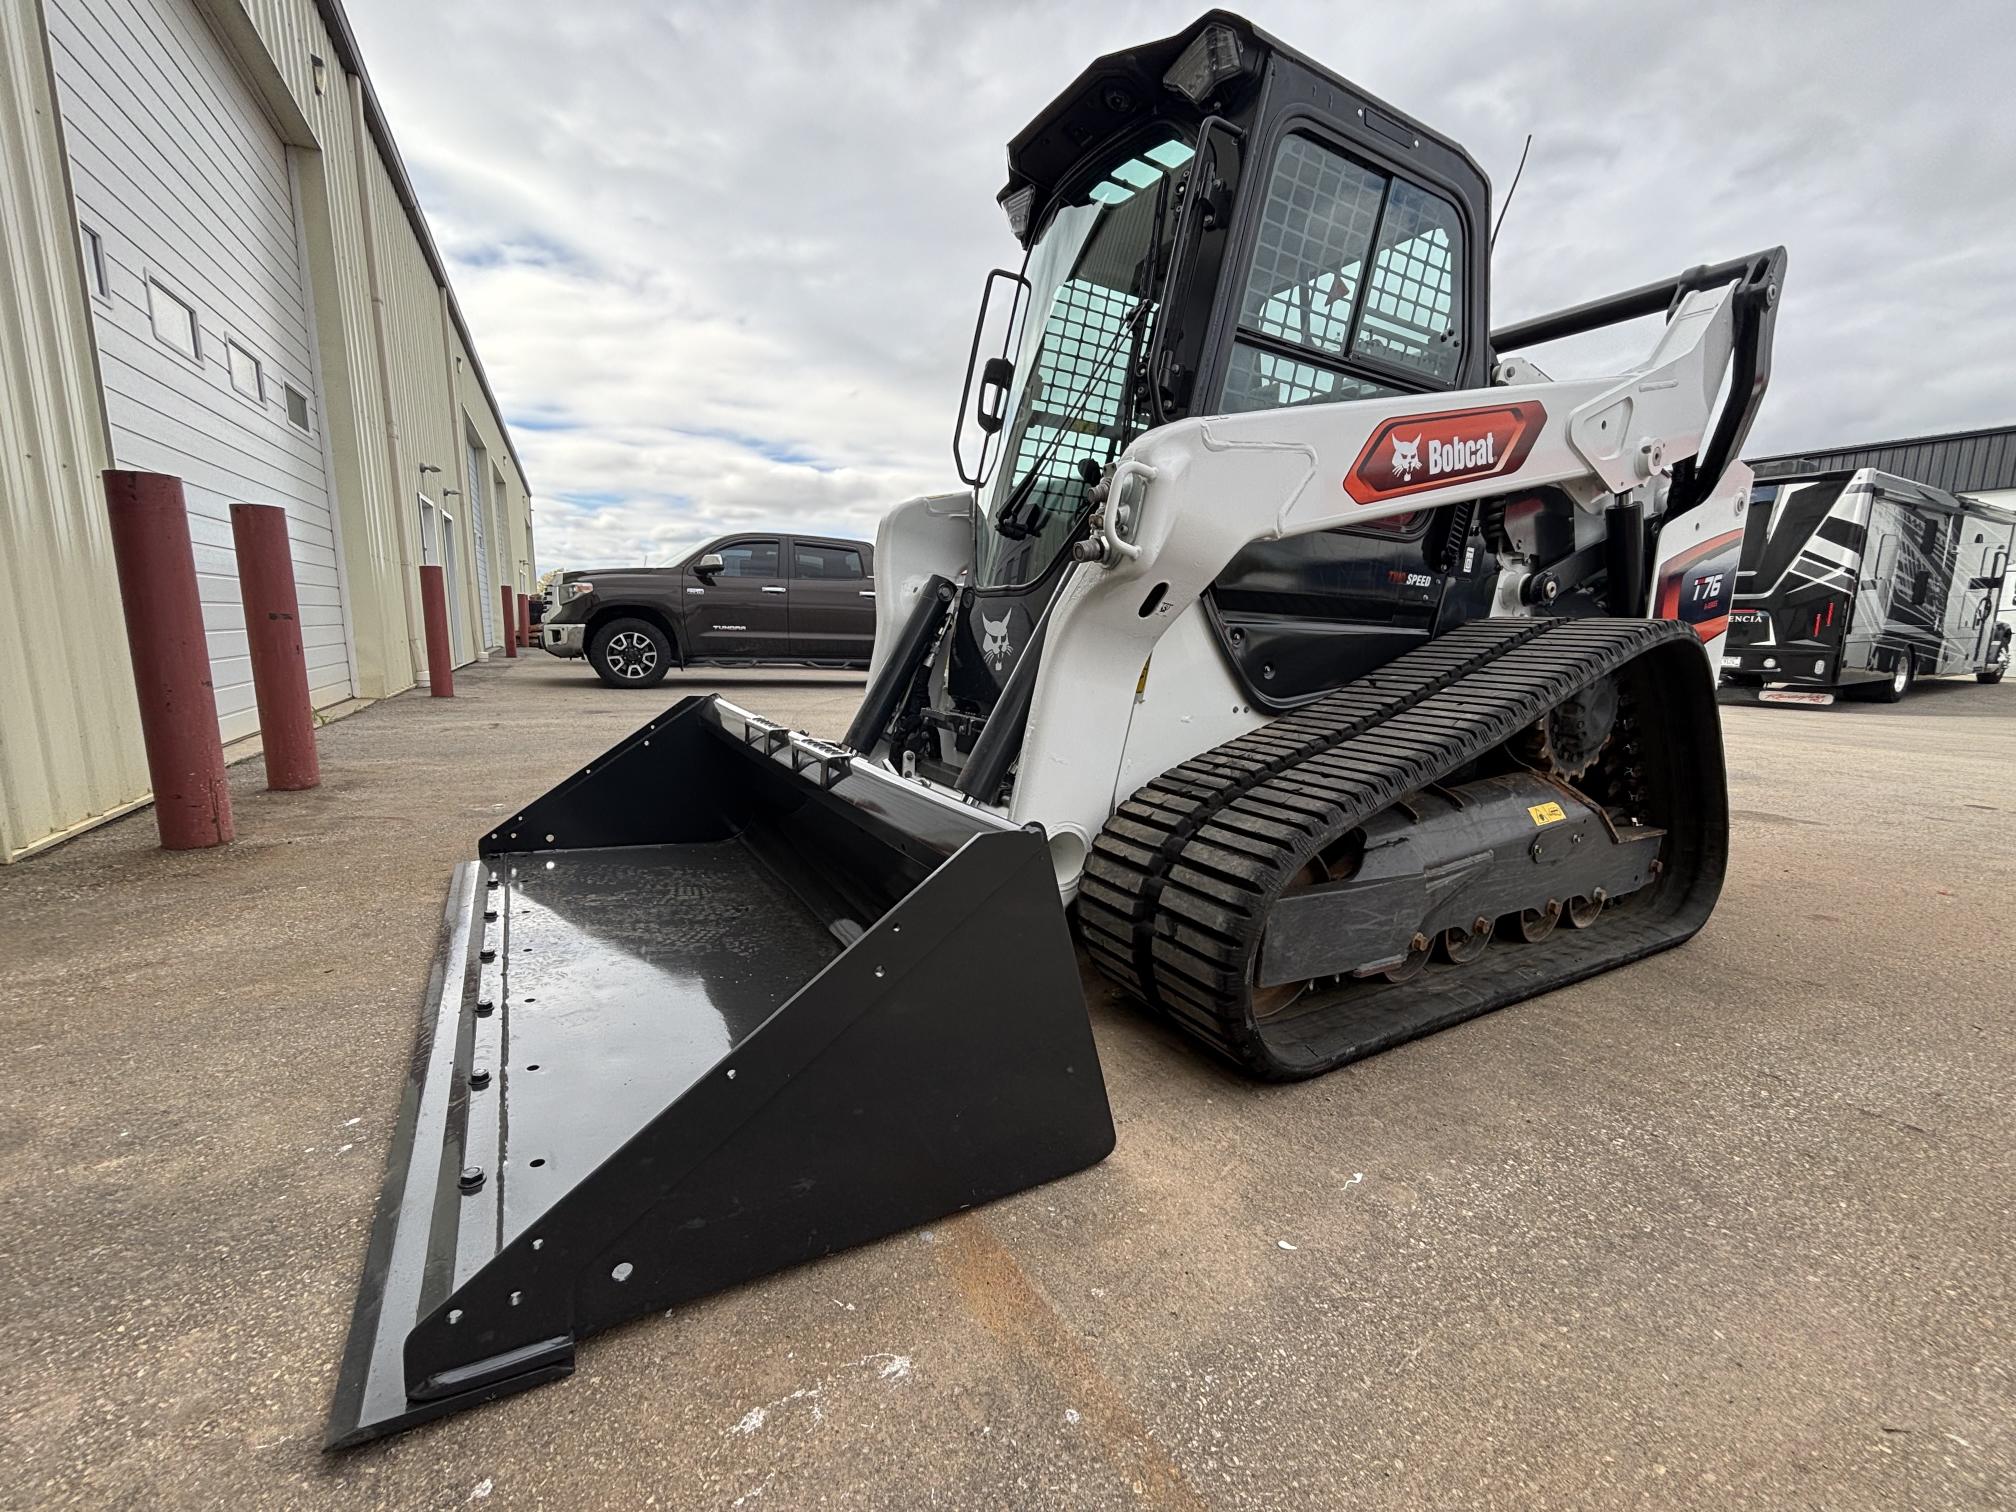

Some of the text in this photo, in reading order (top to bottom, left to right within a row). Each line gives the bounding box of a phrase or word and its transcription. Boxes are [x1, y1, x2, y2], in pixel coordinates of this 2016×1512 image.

[1428, 432, 1493, 475] Bobcat
[1406, 574, 1431, 587] SPEED
[1693, 574, 1723, 601] T76
